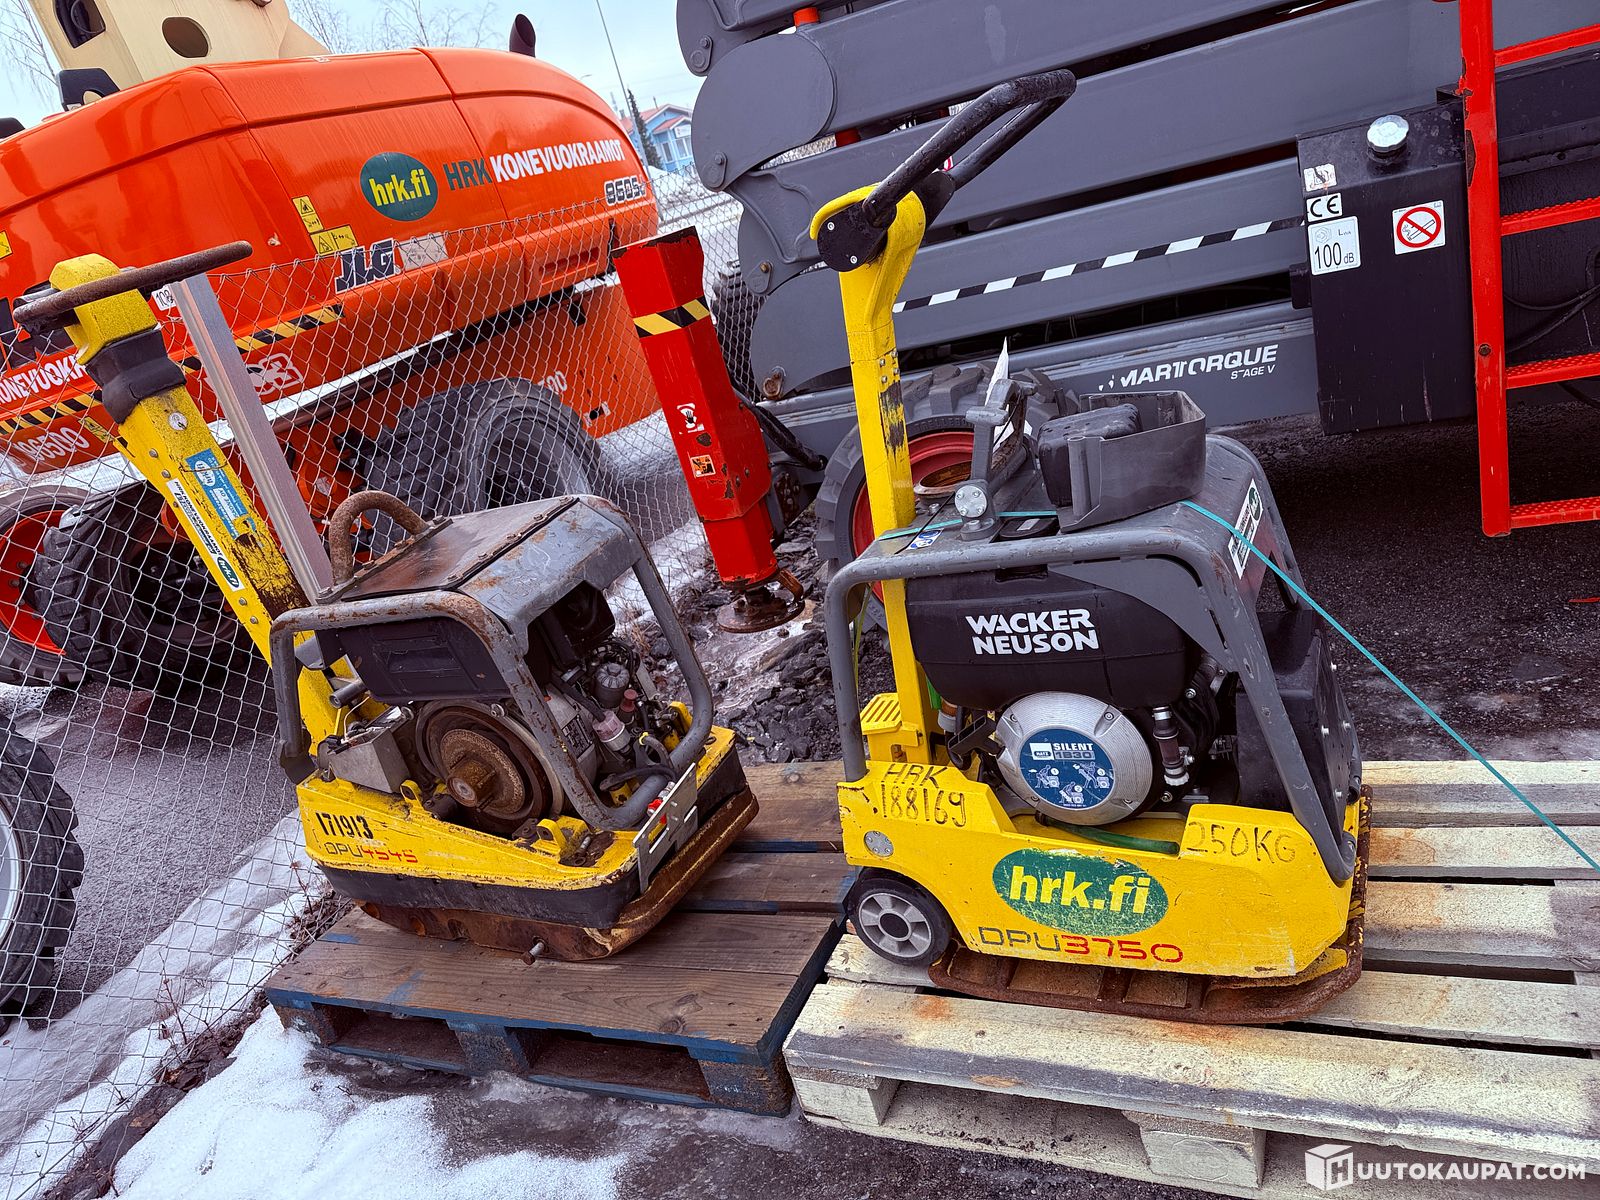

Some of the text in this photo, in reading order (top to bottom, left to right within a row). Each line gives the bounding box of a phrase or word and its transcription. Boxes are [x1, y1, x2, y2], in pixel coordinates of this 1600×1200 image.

[443, 139, 625, 191] HRK KONEVUOKRAAMOT
[369, 169, 431, 206] hrk.fi
[1310, 195, 1339, 217] CE
[334, 238, 396, 294] JLG
[1315, 242, 1355, 269] 100 dB
[1267, 365, 1276, 374] V
[965, 608, 1095, 635] WACKER
[972, 629, 1099, 655] NEUSON
[1053, 743, 1093, 751] SILENT
[1055, 751, 1092, 759] 1B30
[881, 763, 947, 788] HRK
[881, 784, 967, 827] 188169
[316, 812, 374, 840] 171913
[1009, 866, 1151, 914] hrk.fi
[978, 927, 1184, 963] DPU3750
